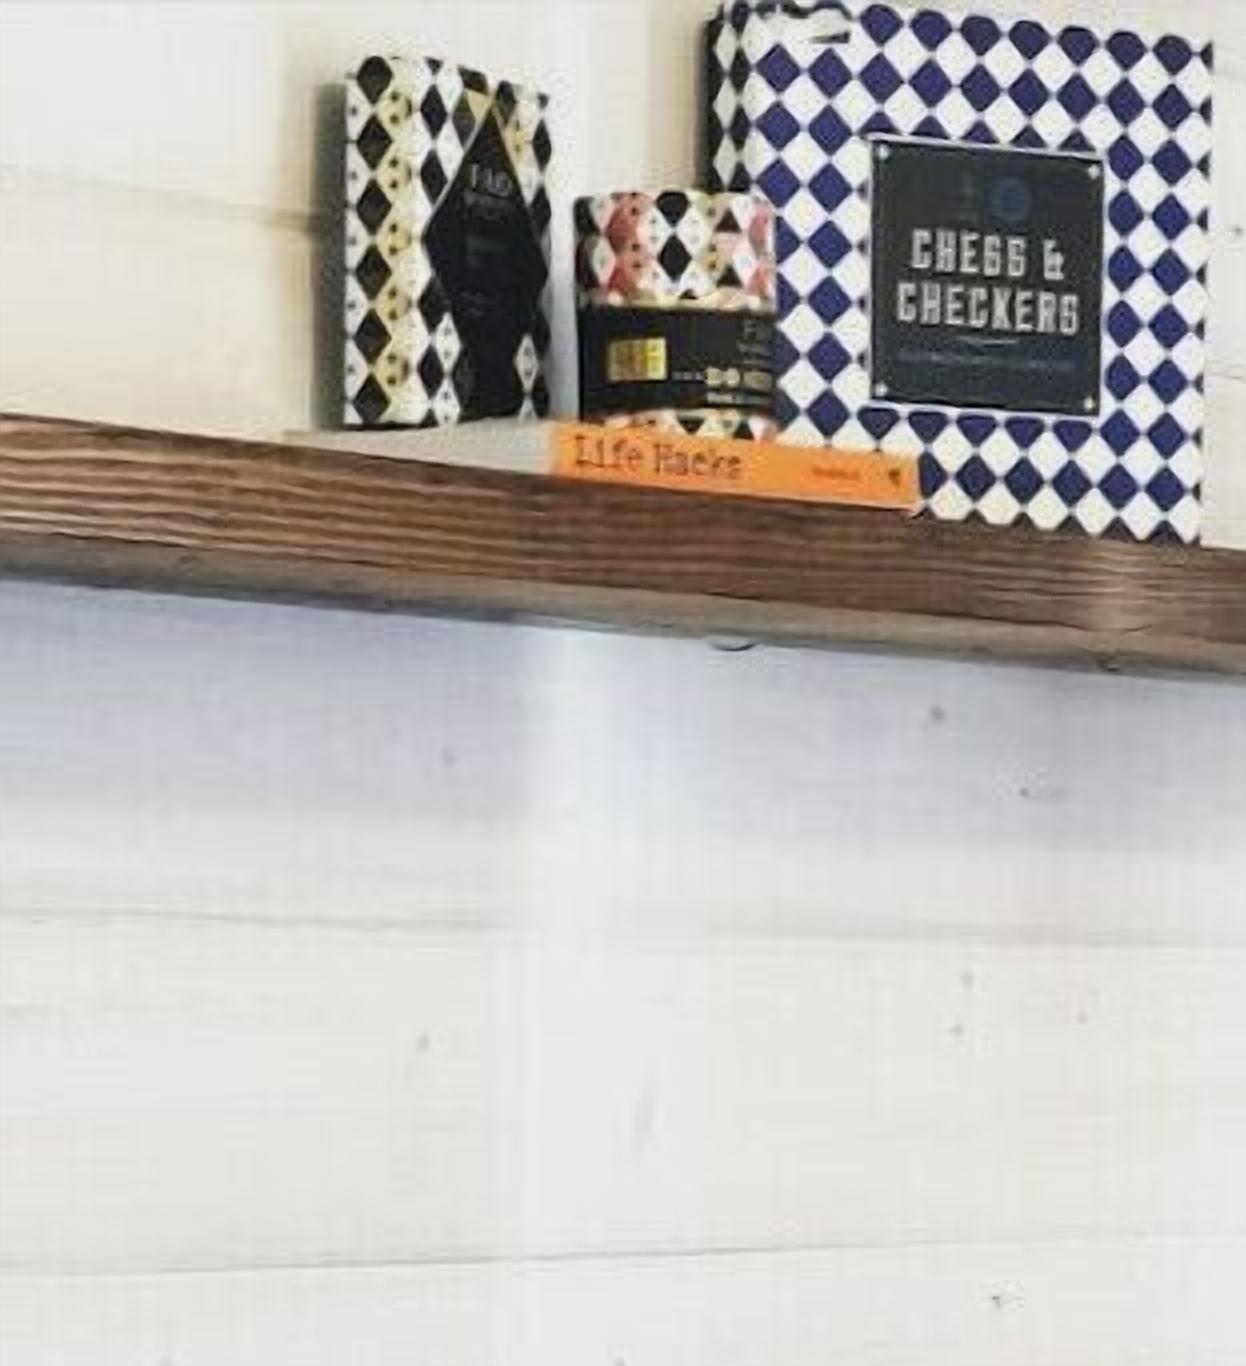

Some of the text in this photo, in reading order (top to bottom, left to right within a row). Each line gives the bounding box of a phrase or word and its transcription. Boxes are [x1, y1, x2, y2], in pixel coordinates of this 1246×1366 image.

[911, 228, 1065, 281] CHESS &
[897, 281, 1079, 335] CHECKERS
[575, 433, 643, 473] Life
